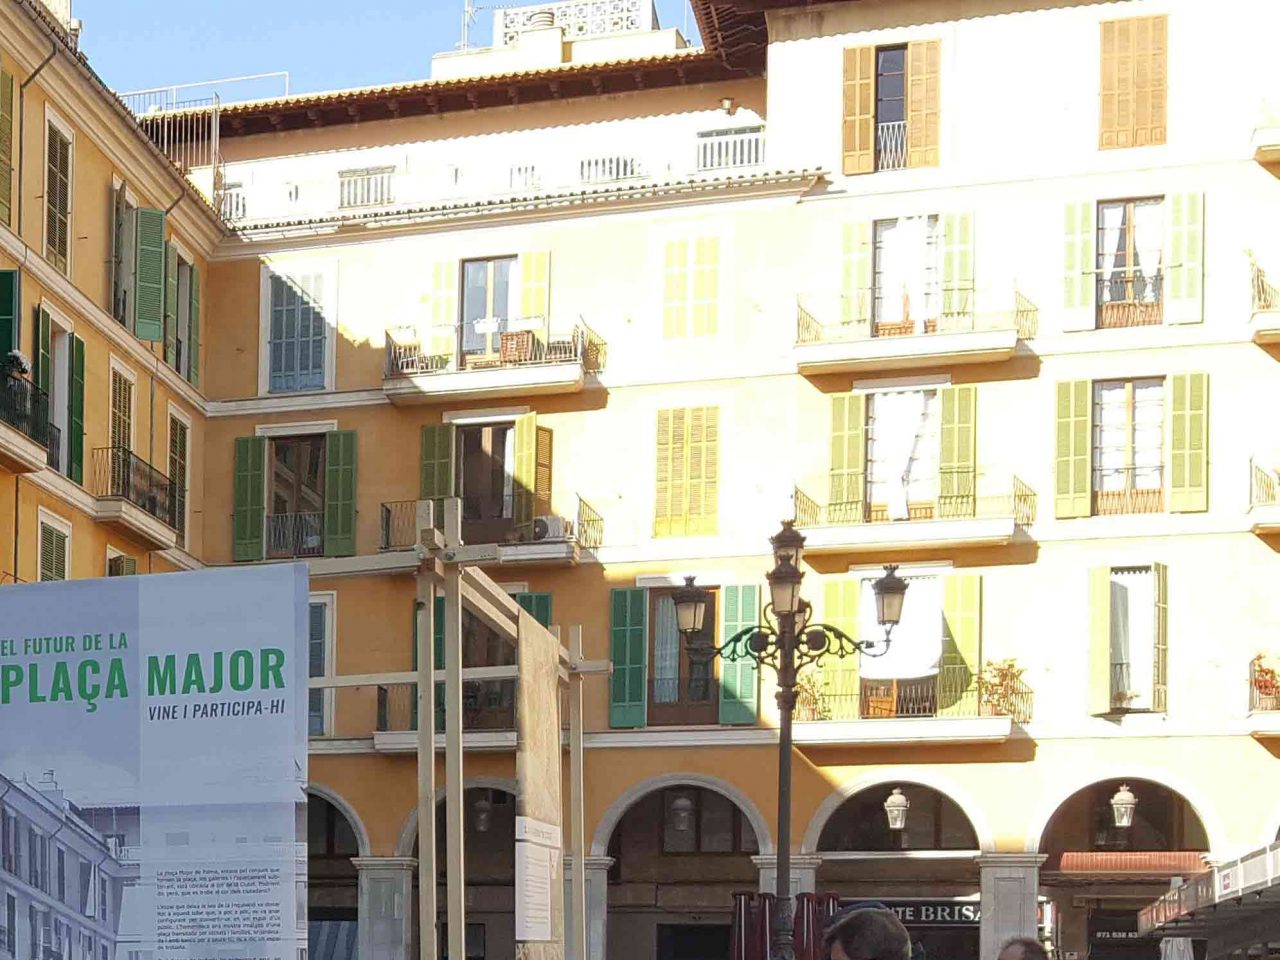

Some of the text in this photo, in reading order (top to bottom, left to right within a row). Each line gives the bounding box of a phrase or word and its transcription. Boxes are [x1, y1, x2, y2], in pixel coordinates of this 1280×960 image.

[0, 632, 128, 656] EL FUTUR DE LA
[0, 648, 286, 713] PLAÇA MAJOR
[149, 699, 286, 721] VINE I PARTICIPA-HI
